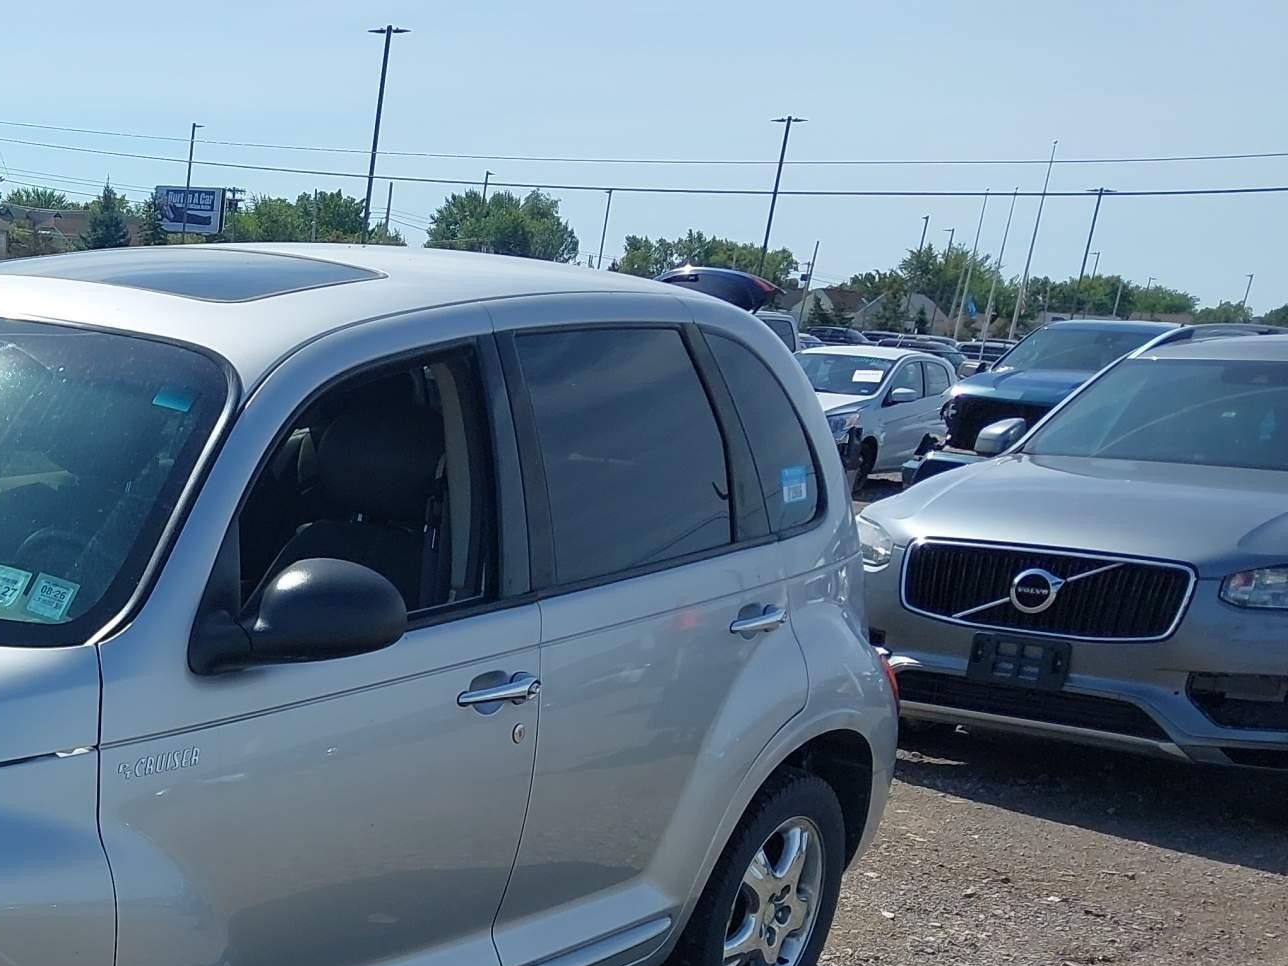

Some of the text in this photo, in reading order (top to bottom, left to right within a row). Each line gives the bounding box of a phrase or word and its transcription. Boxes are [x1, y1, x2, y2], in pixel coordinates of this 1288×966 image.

[199, 192, 214, 205] Car
[1, 586, 18, 598] 27
[1017, 586, 1049, 595] VOLVO
[134, 746, 200, 777] CRUISER
